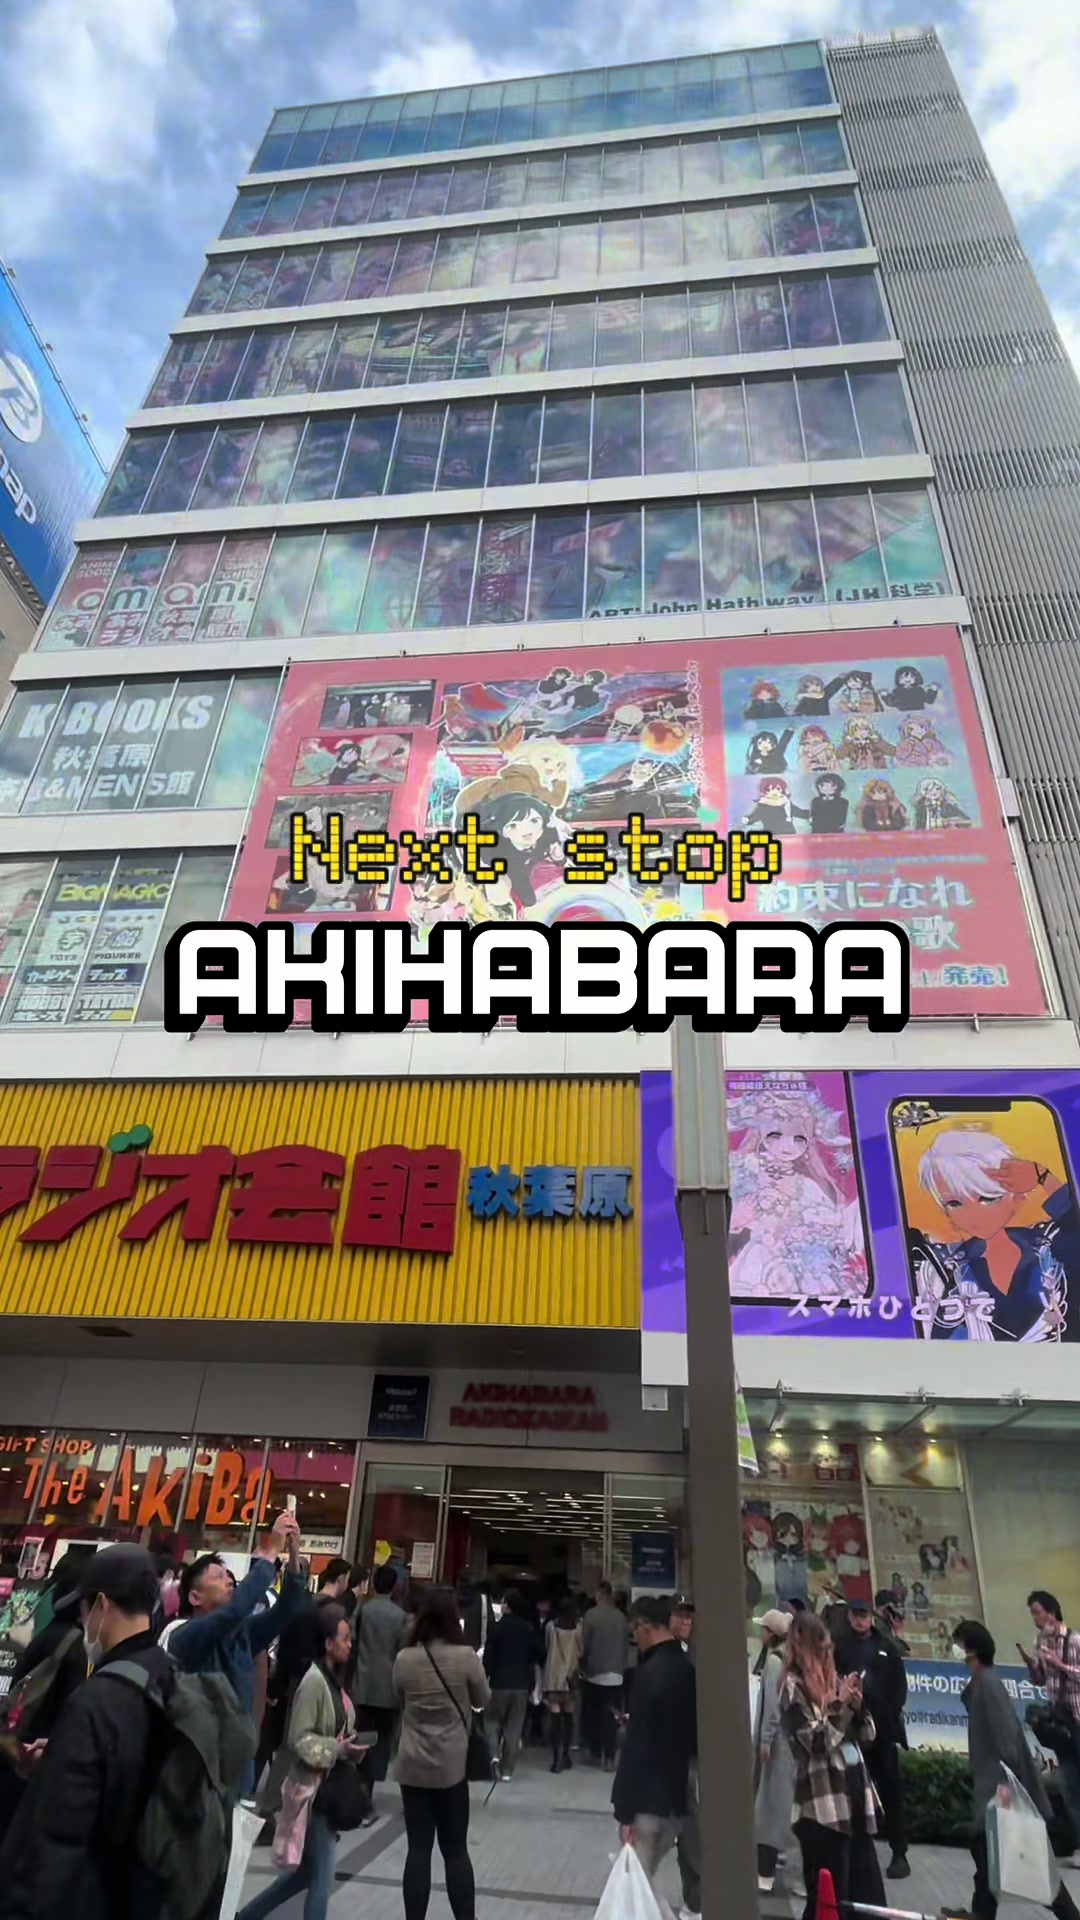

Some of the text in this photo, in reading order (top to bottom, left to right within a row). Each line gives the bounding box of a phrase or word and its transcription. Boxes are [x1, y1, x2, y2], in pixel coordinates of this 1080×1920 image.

[757, 876, 974, 913] 約束になれ
[467, 1164, 635, 1222] 秋葉原
[788, 1294, 996, 1323] スマホひとつで
[462, 1382, 598, 1406] AKIHABARA
[41, 1439, 93, 1456] SHOP
[24, 1456, 88, 1508] The
